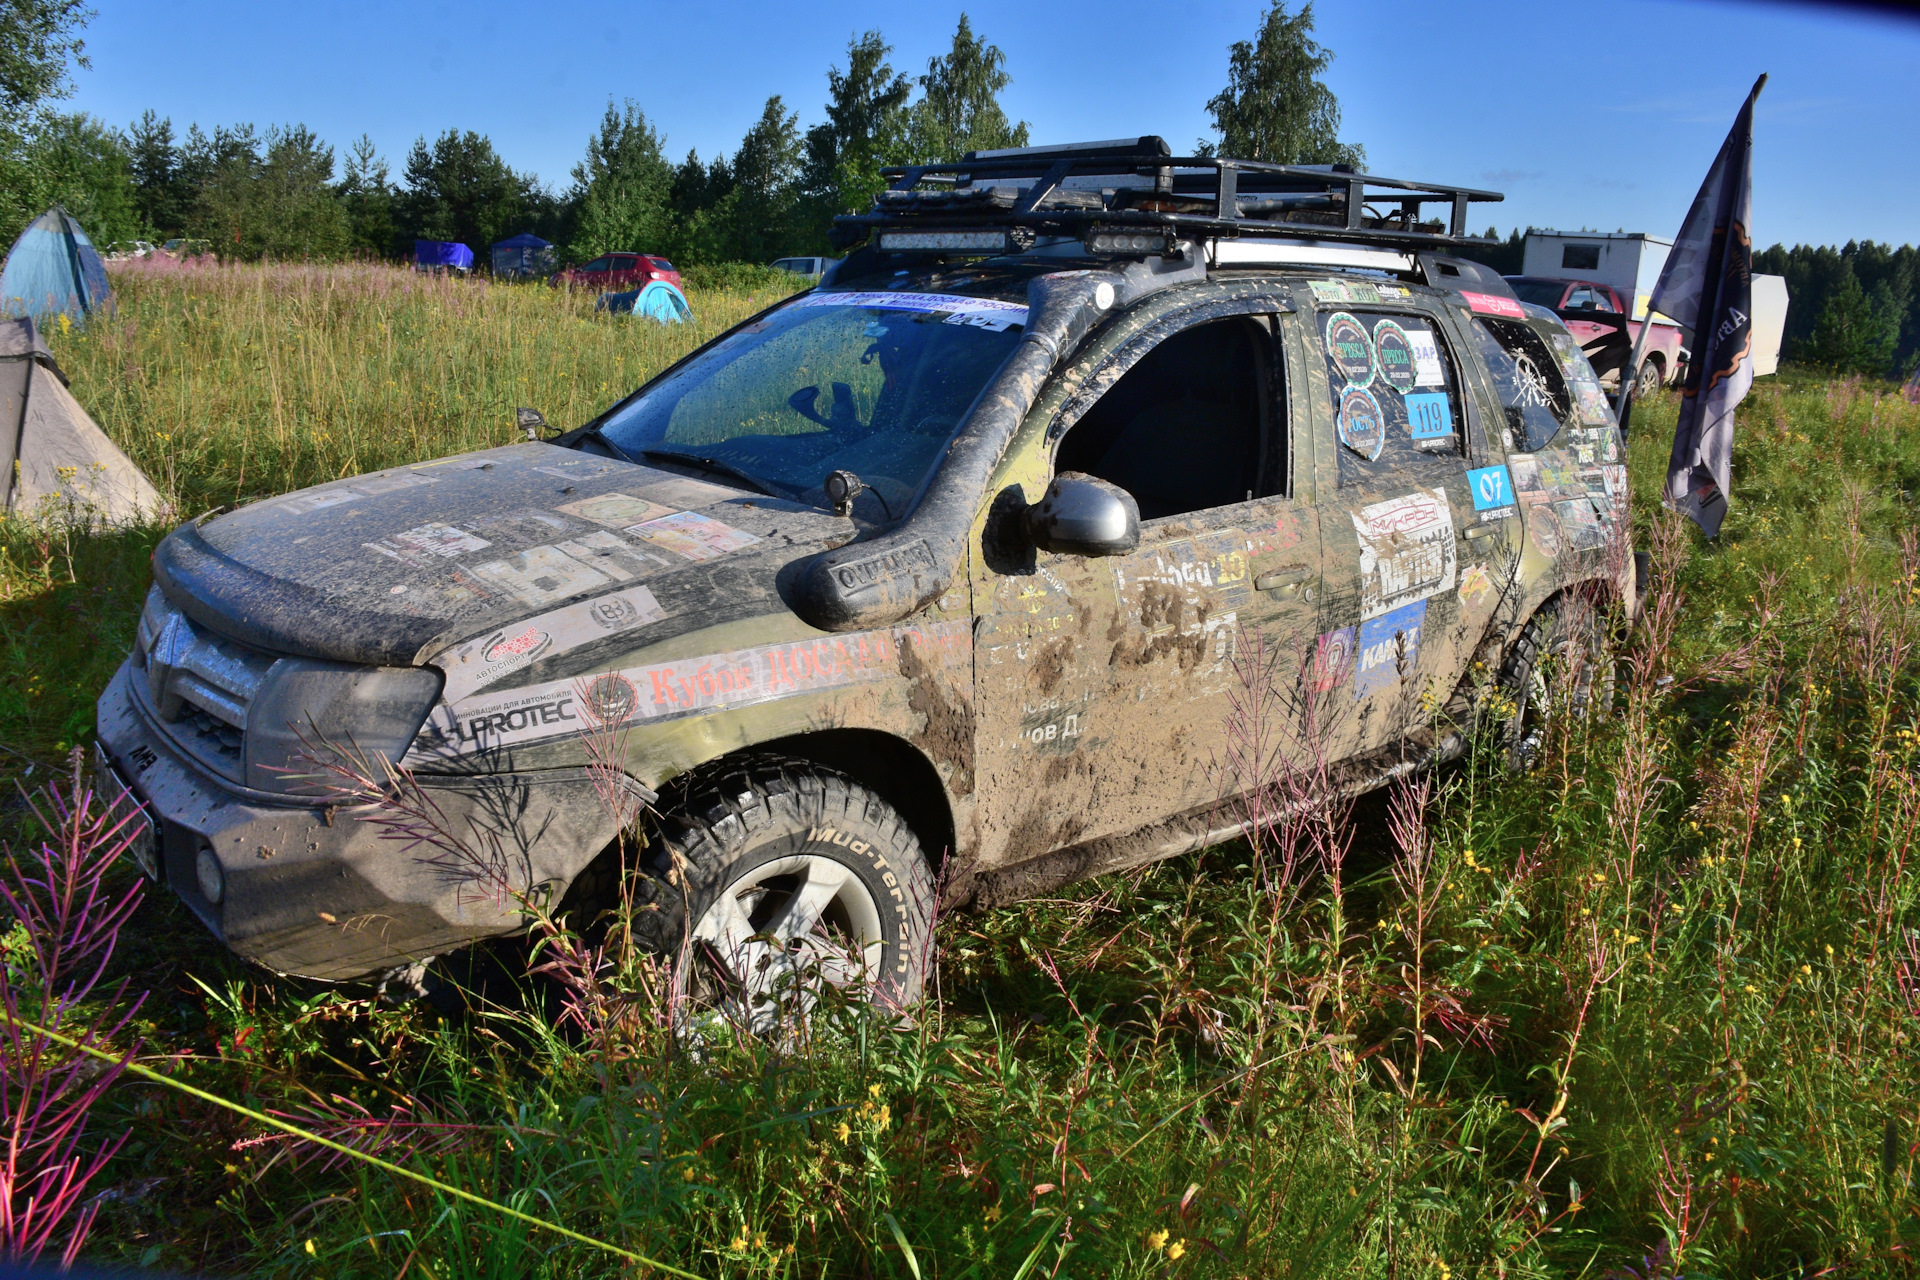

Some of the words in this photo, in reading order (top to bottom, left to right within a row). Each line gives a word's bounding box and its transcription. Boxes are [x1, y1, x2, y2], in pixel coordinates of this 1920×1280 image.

[1381, 349, 1410, 365] ПРЕССА
[1416, 402, 1443, 434] 119
[1480, 471, 1503, 502] 07
[1371, 505, 1437, 533] МИКРОН
[475, 653, 526, 681] АВТОСПОРТ
[647, 663, 751, 708] Кубок
[455, 704, 501, 721] ИННОВАЦИИ
[503, 701, 519, 711] ДЛЯ
[521, 690, 573, 707] АВТОМОБИЛЯ
